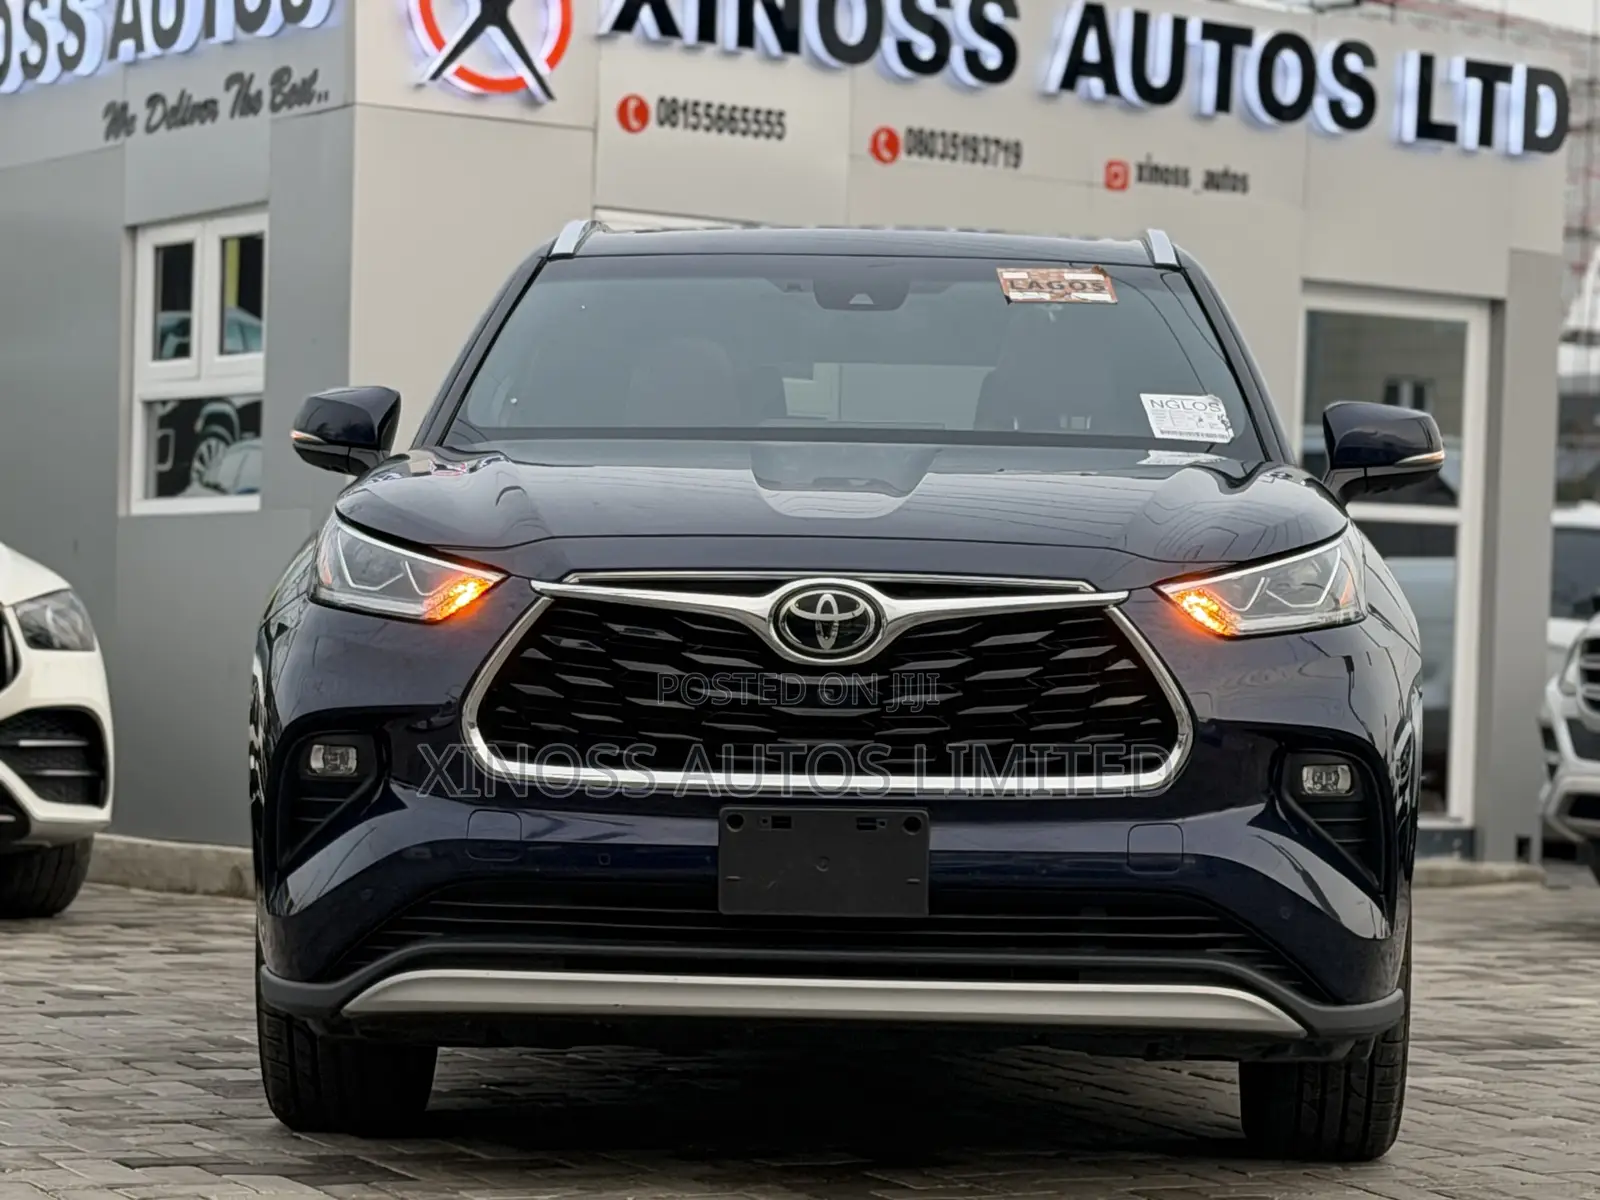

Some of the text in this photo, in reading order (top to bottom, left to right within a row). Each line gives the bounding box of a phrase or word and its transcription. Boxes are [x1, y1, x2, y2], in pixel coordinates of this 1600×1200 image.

[1055, 2, 1378, 131] AUTOS
[1414, 53, 1570, 154] LTD
[224, 72, 263, 119] The
[1009, 280, 1106, 292] LAGOS
[1149, 399, 1222, 413] NGLOS
